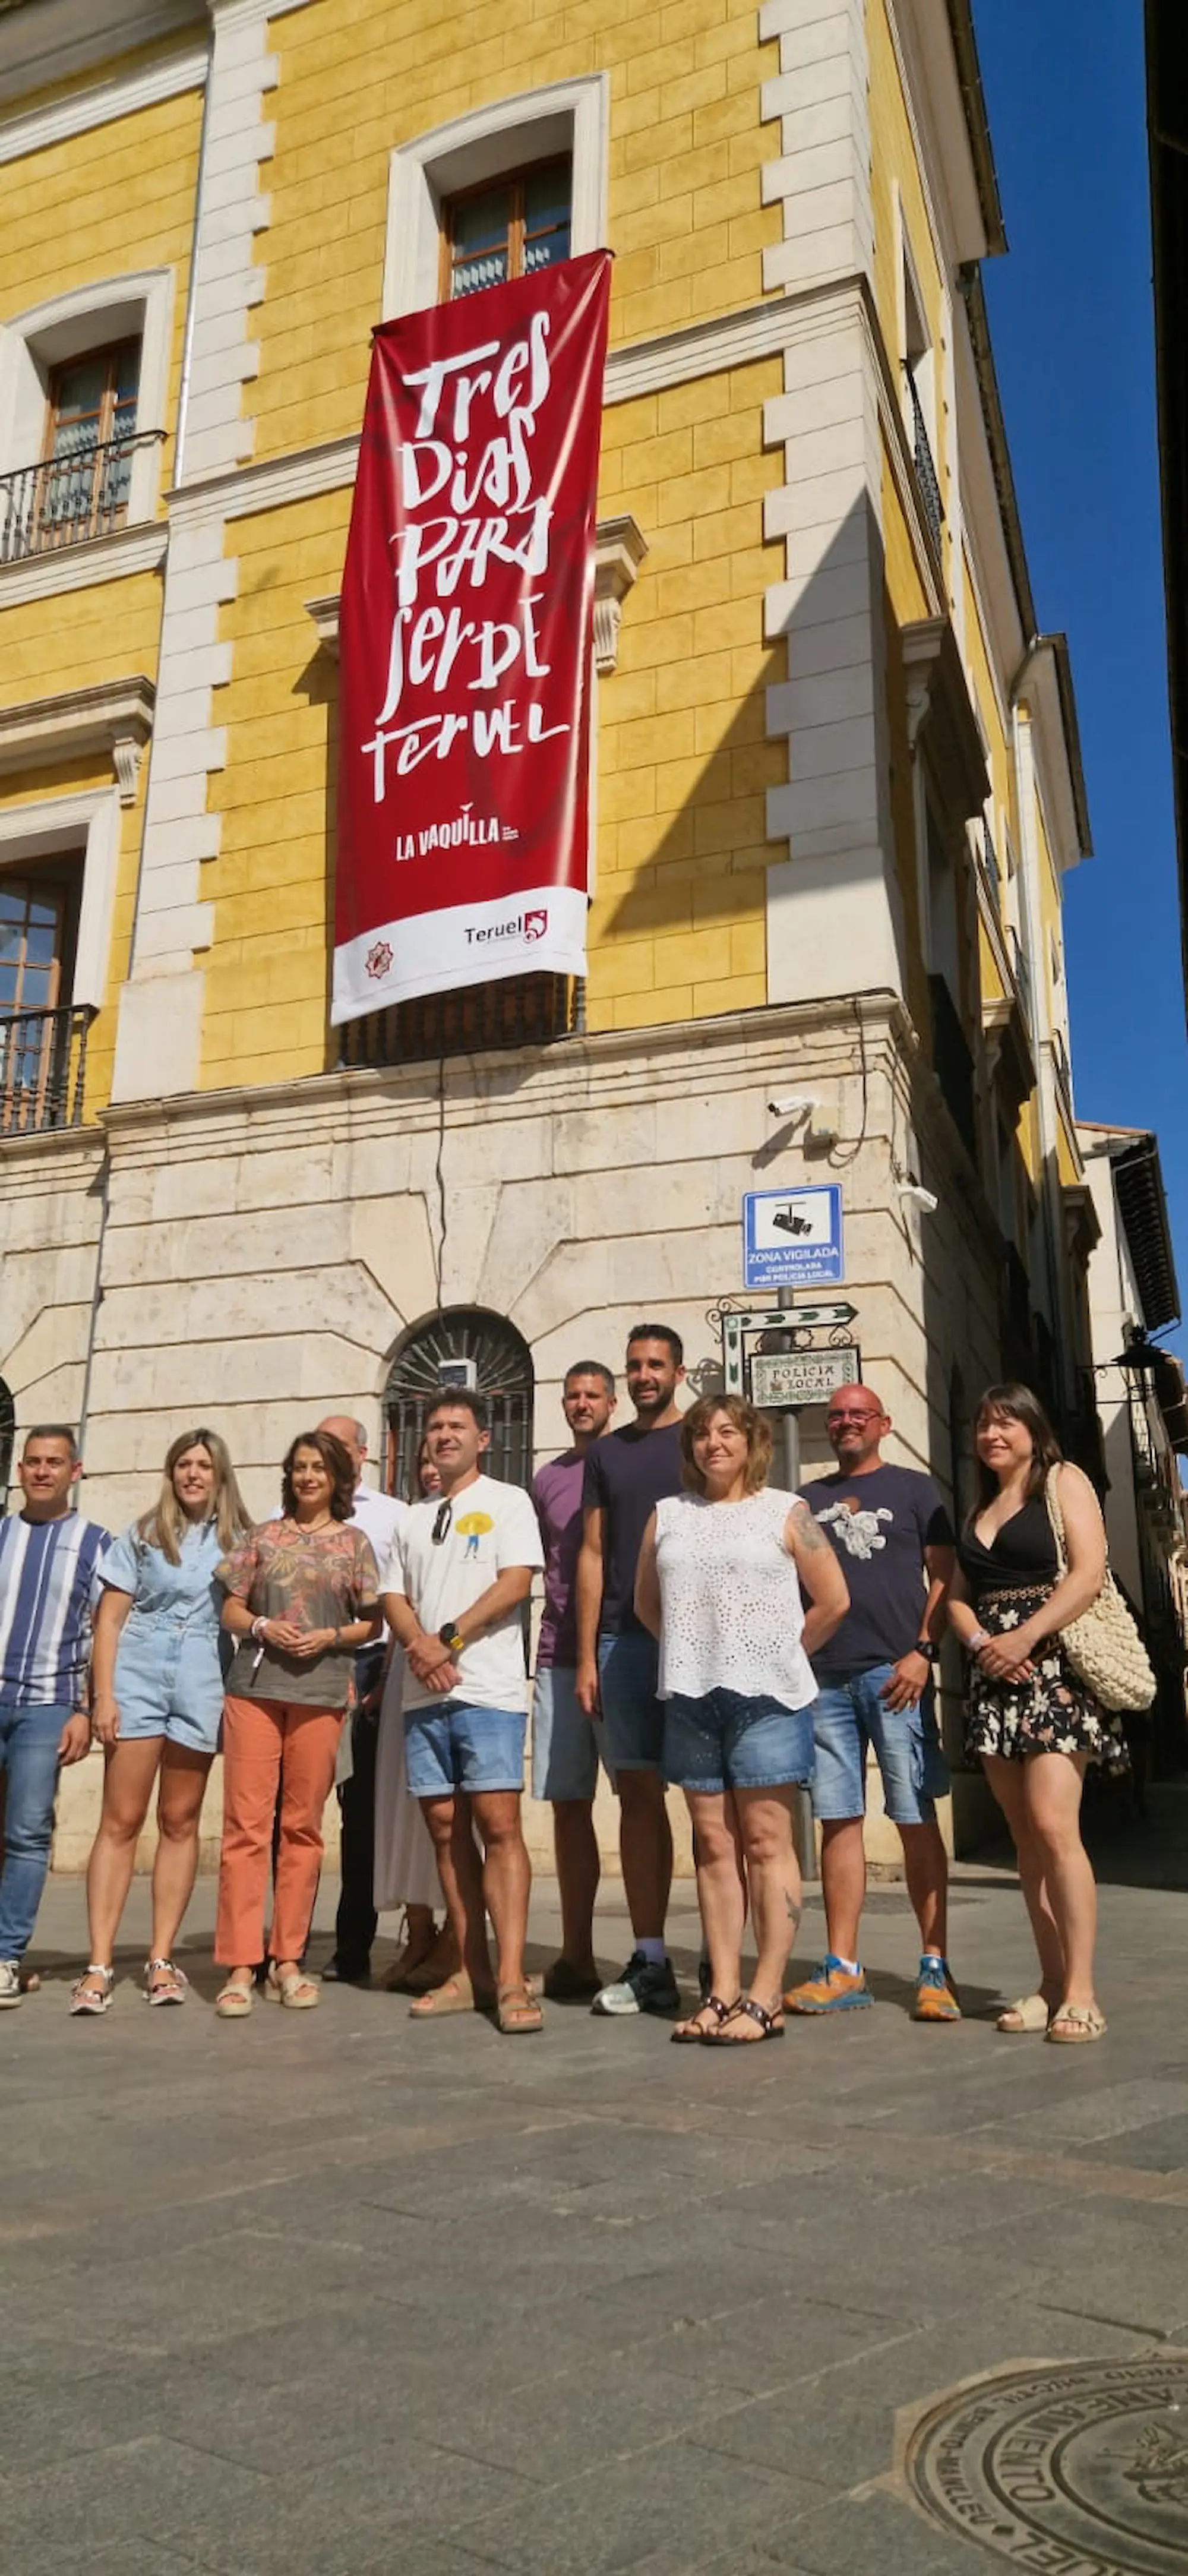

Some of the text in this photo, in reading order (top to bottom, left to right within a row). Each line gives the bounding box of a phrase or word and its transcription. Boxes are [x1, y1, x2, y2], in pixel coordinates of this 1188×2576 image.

[396, 802, 500, 861] LA VAQUILLA
[465, 916, 522, 944] Teruel
[748, 1246, 839, 1264] ZONA VIGILADA
[773, 1365, 834, 1379] POLICIA
[788, 1378, 834, 1390] LOCAL
[999, 2386, 1188, 2502] ANEAMIENTO
